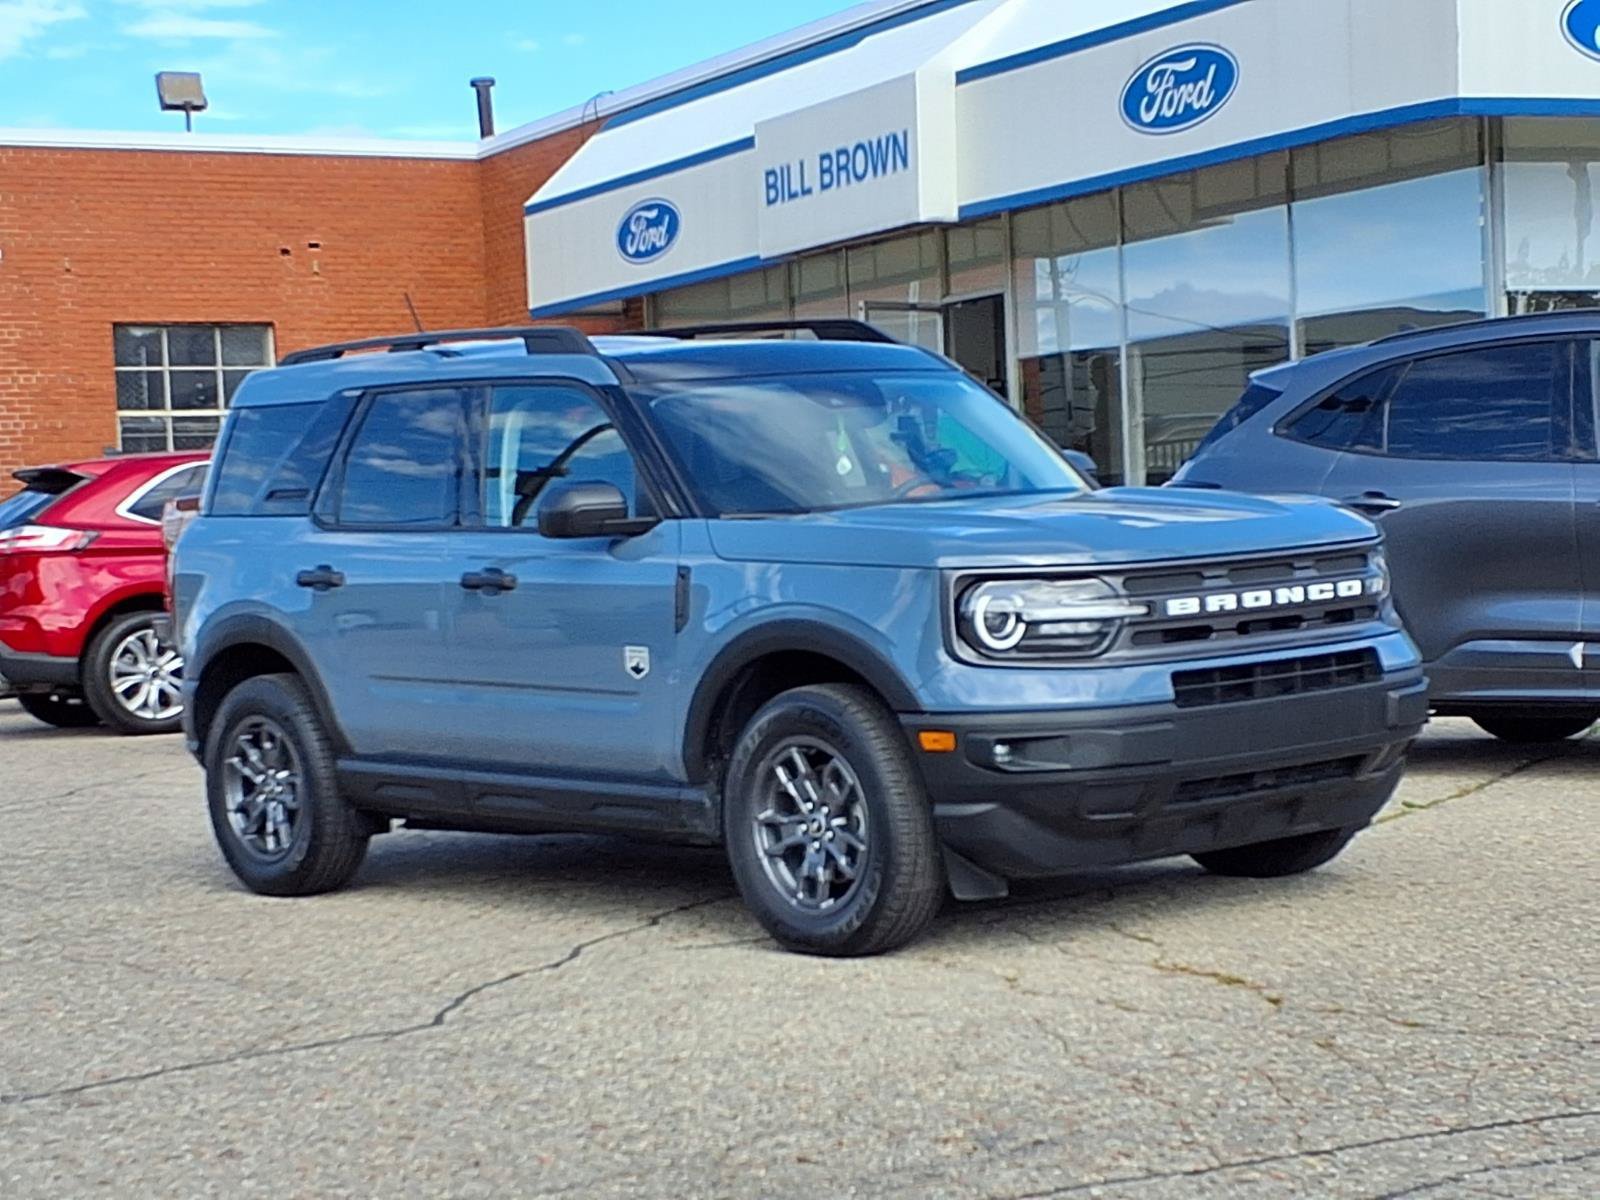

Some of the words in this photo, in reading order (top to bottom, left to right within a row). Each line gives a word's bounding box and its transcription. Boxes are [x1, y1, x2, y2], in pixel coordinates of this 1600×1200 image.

[1140, 57, 1217, 123] Ford
[764, 159, 813, 206] BILL
[819, 129, 909, 192] BROWN
[626, 208, 670, 255] Ford
[1166, 579, 1363, 616] BRONCO
